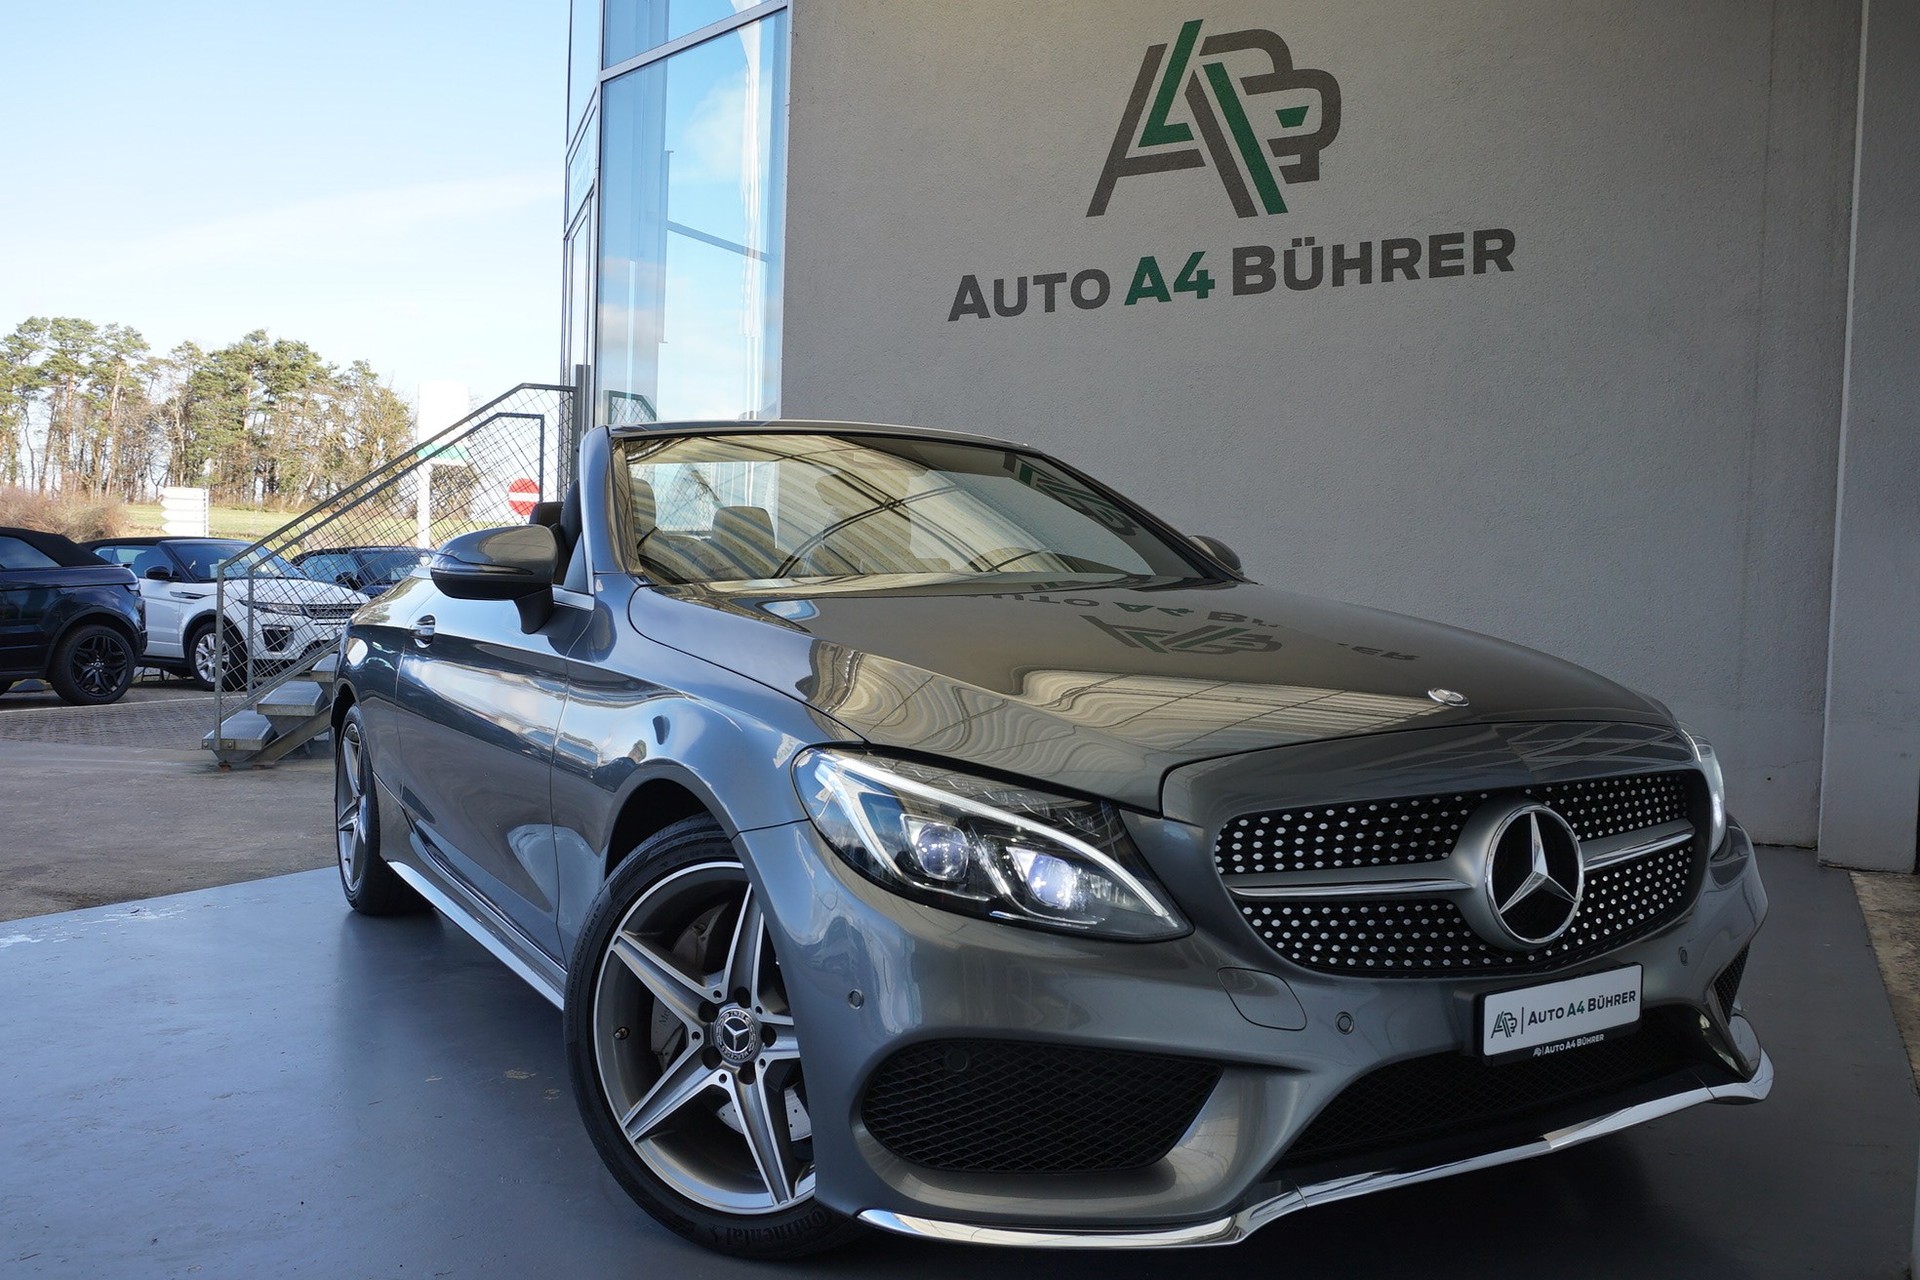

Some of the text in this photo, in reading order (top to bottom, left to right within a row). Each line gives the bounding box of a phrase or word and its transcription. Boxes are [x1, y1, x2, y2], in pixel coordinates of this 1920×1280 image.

[947, 227, 1517, 322] AUTO A4 BÜHRER
[1527, 990, 1637, 1026] AUTO A4 BÜHRER
[1544, 1033, 1605, 1055] AUTO A4 BÜHRER
